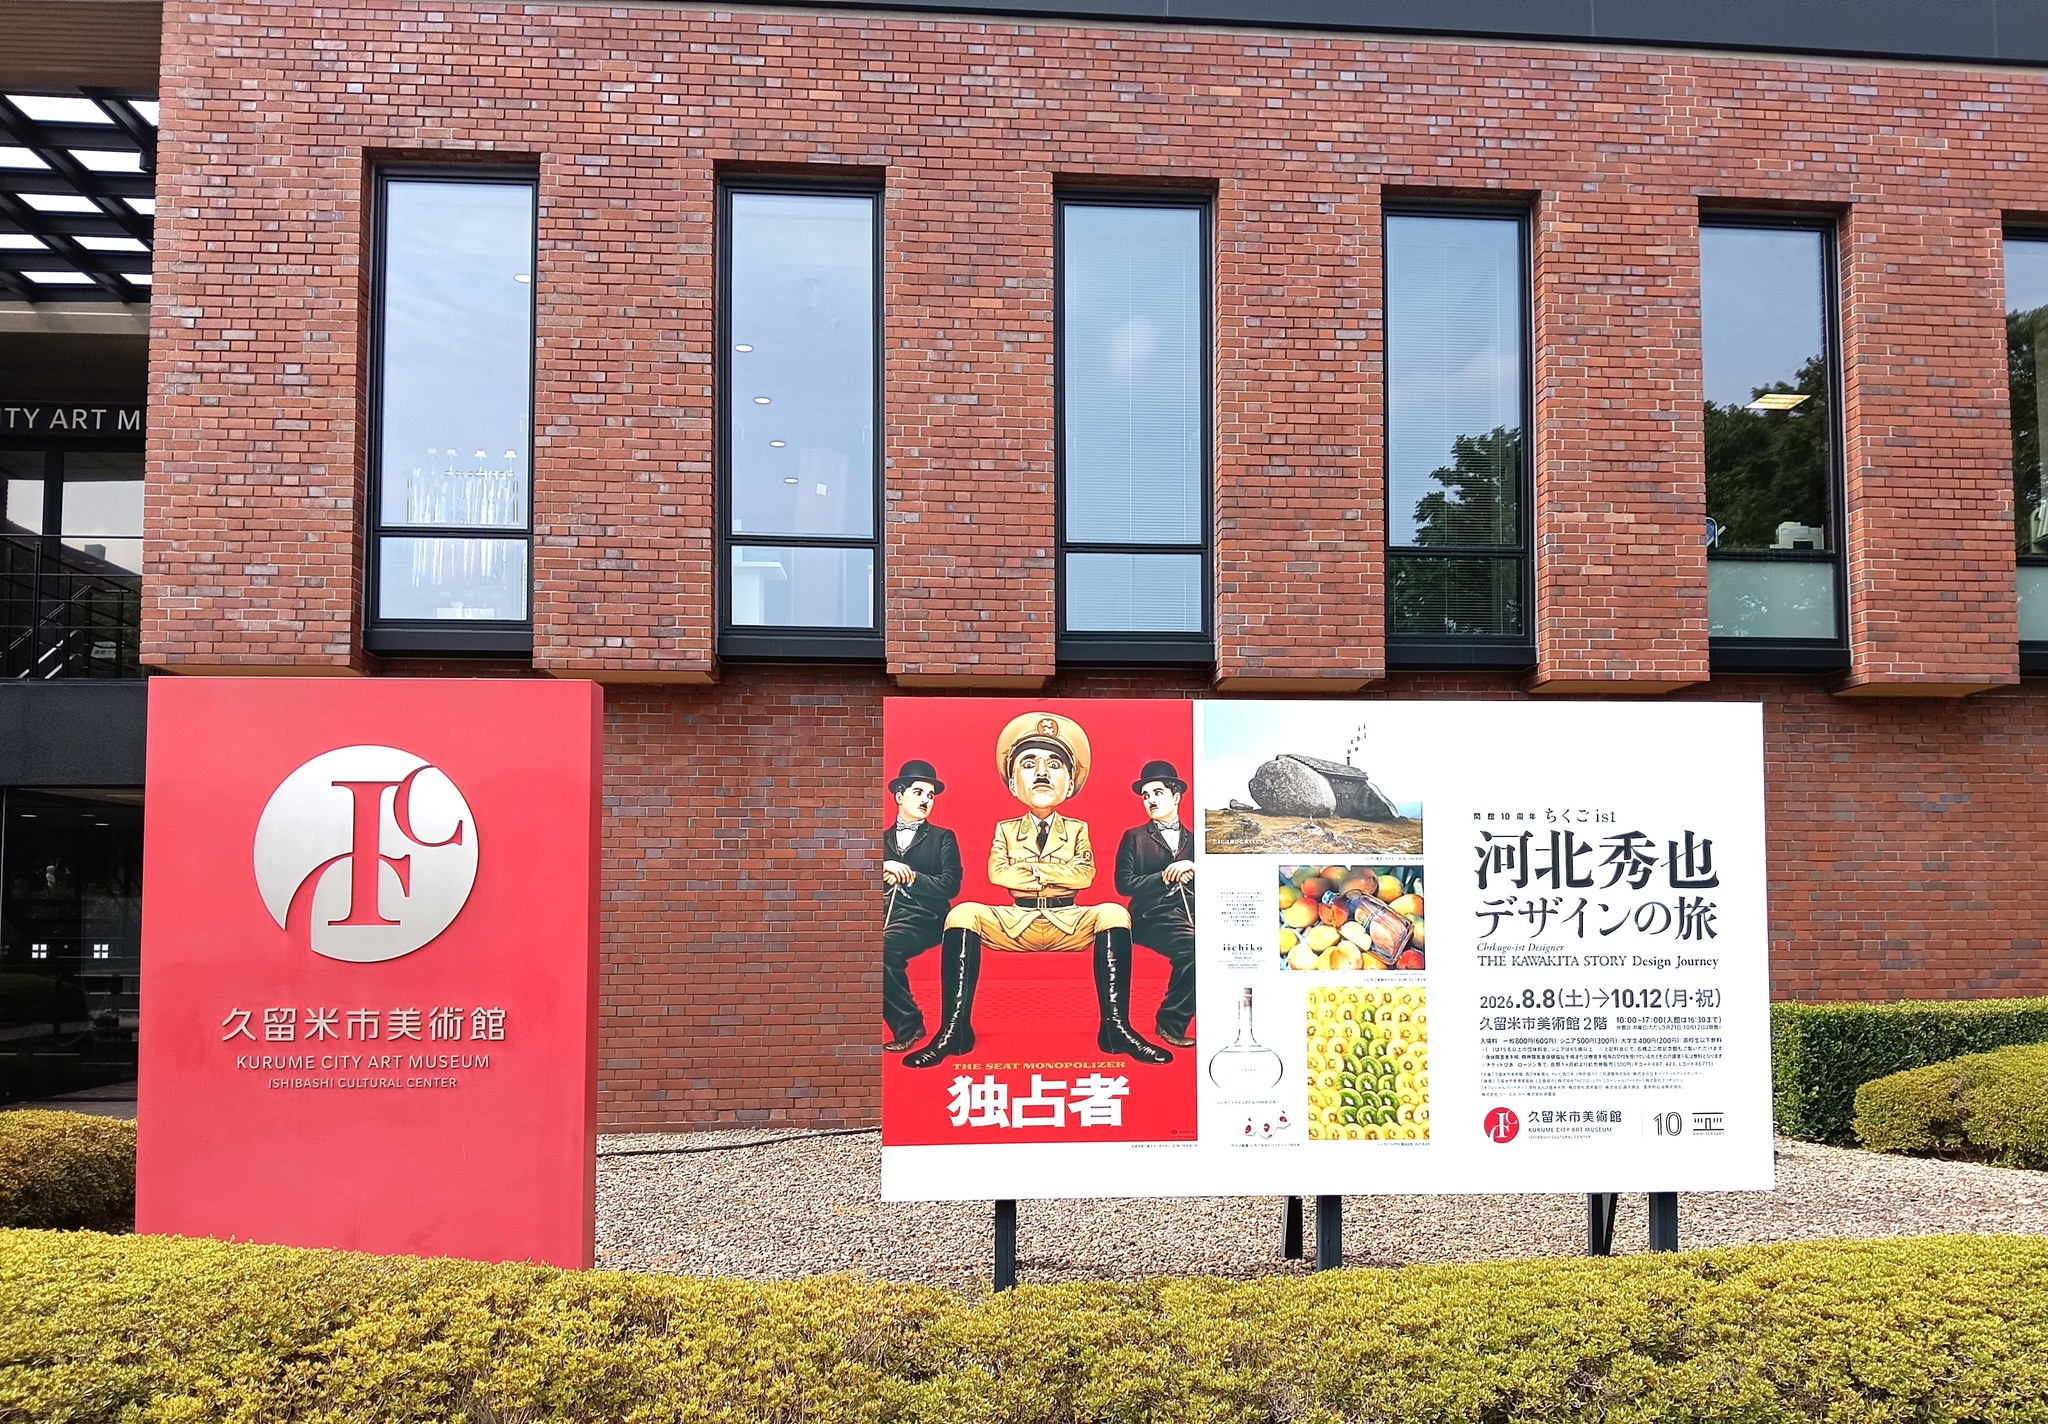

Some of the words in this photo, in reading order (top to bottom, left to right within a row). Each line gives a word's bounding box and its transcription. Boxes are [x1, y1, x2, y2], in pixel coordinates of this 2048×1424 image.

[0, 408, 40, 428] TY
[49, 409, 106, 429] ART
[1475, 830, 1719, 890] 河北秀也
[1476, 896, 1717, 940] デザインの旅
[1223, 944, 1263, 952] iichiko
[1477, 943, 1525, 953] Chikugo-ist
[1528, 943, 1564, 953] Designer
[1477, 956, 1506, 966] THE
[1512, 956, 1579, 966] KAWAKITA
[1584, 956, 1626, 966] STORY
[1633, 956, 1671, 970] Design
[1676, 956, 1718, 969] Journey
[222, 1007, 507, 1042] 久留米市美術館
[237, 1055, 315, 1070] KURUME
[322, 1055, 363, 1070] CITY
[368, 1055, 403, 1069] ART
[409, 1055, 490, 1069] MUSEUM
[952, 1064, 982, 1072] THE
[985, 1062, 1021, 1071] SEAT
[1022, 1062, 1126, 1071] MONOPOLIZER
[269, 1078, 334, 1089] ISHIBASHI
[338, 1078, 403, 1089] CULTURAL
[407, 1078, 457, 1088] CENTER
[947, 1073, 1130, 1128] 独占者
[1529, 1111, 1621, 1123] 久留米市美術館
[1654, 1112, 1682, 1136] 10
